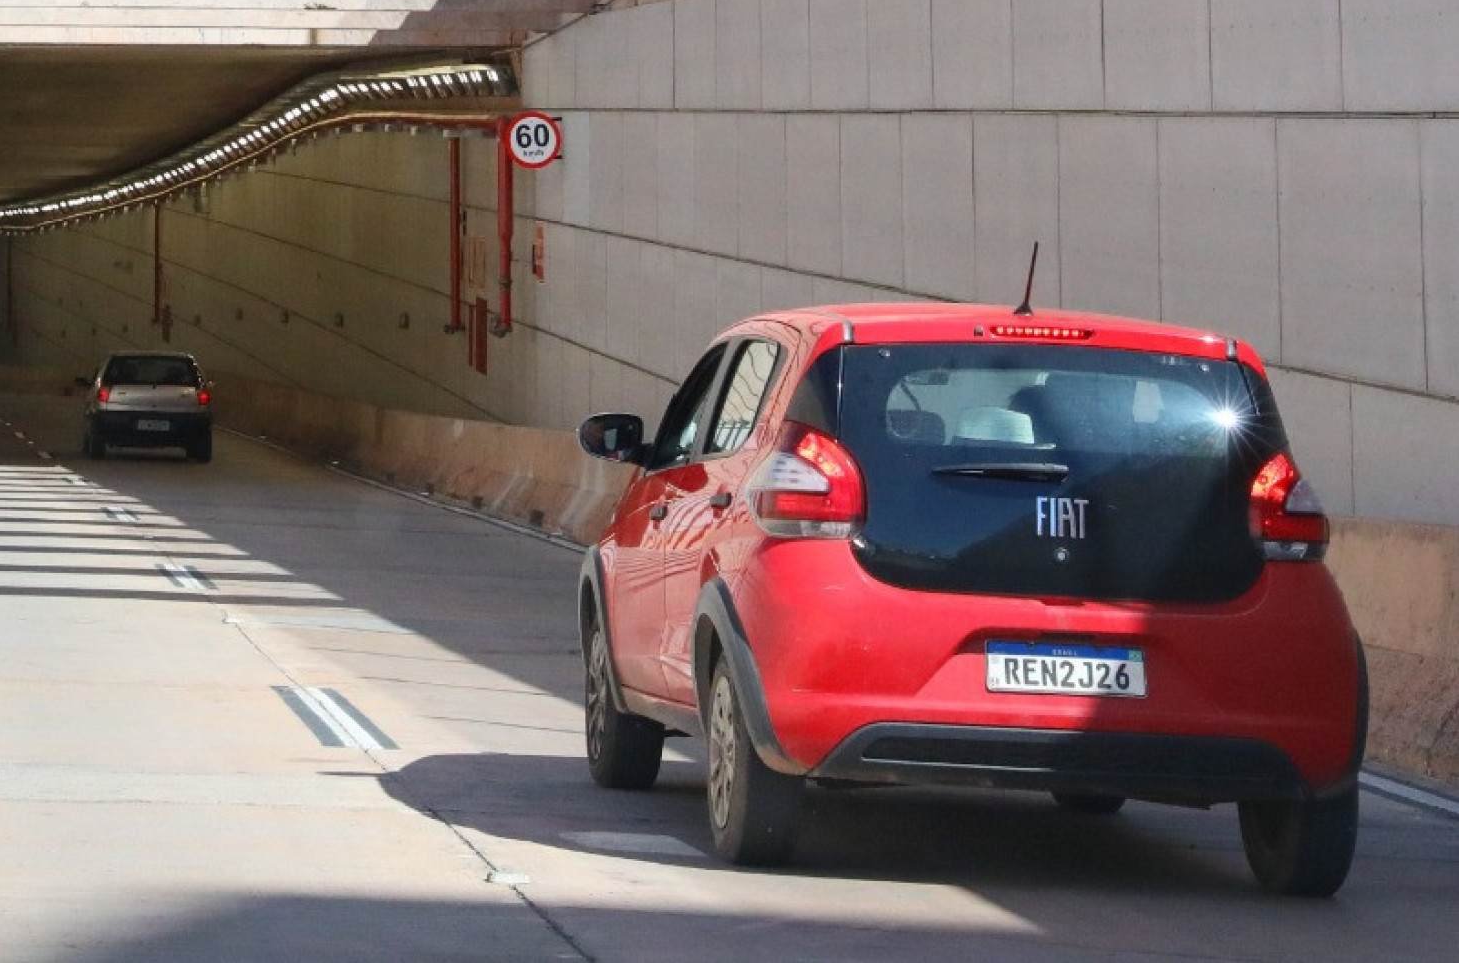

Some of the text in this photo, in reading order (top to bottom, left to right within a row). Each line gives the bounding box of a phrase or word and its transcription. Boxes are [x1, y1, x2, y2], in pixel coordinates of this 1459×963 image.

[516, 123, 550, 148] 60
[1036, 496, 1089, 538] FIAT
[1004, 658, 1130, 690] REN2J26
